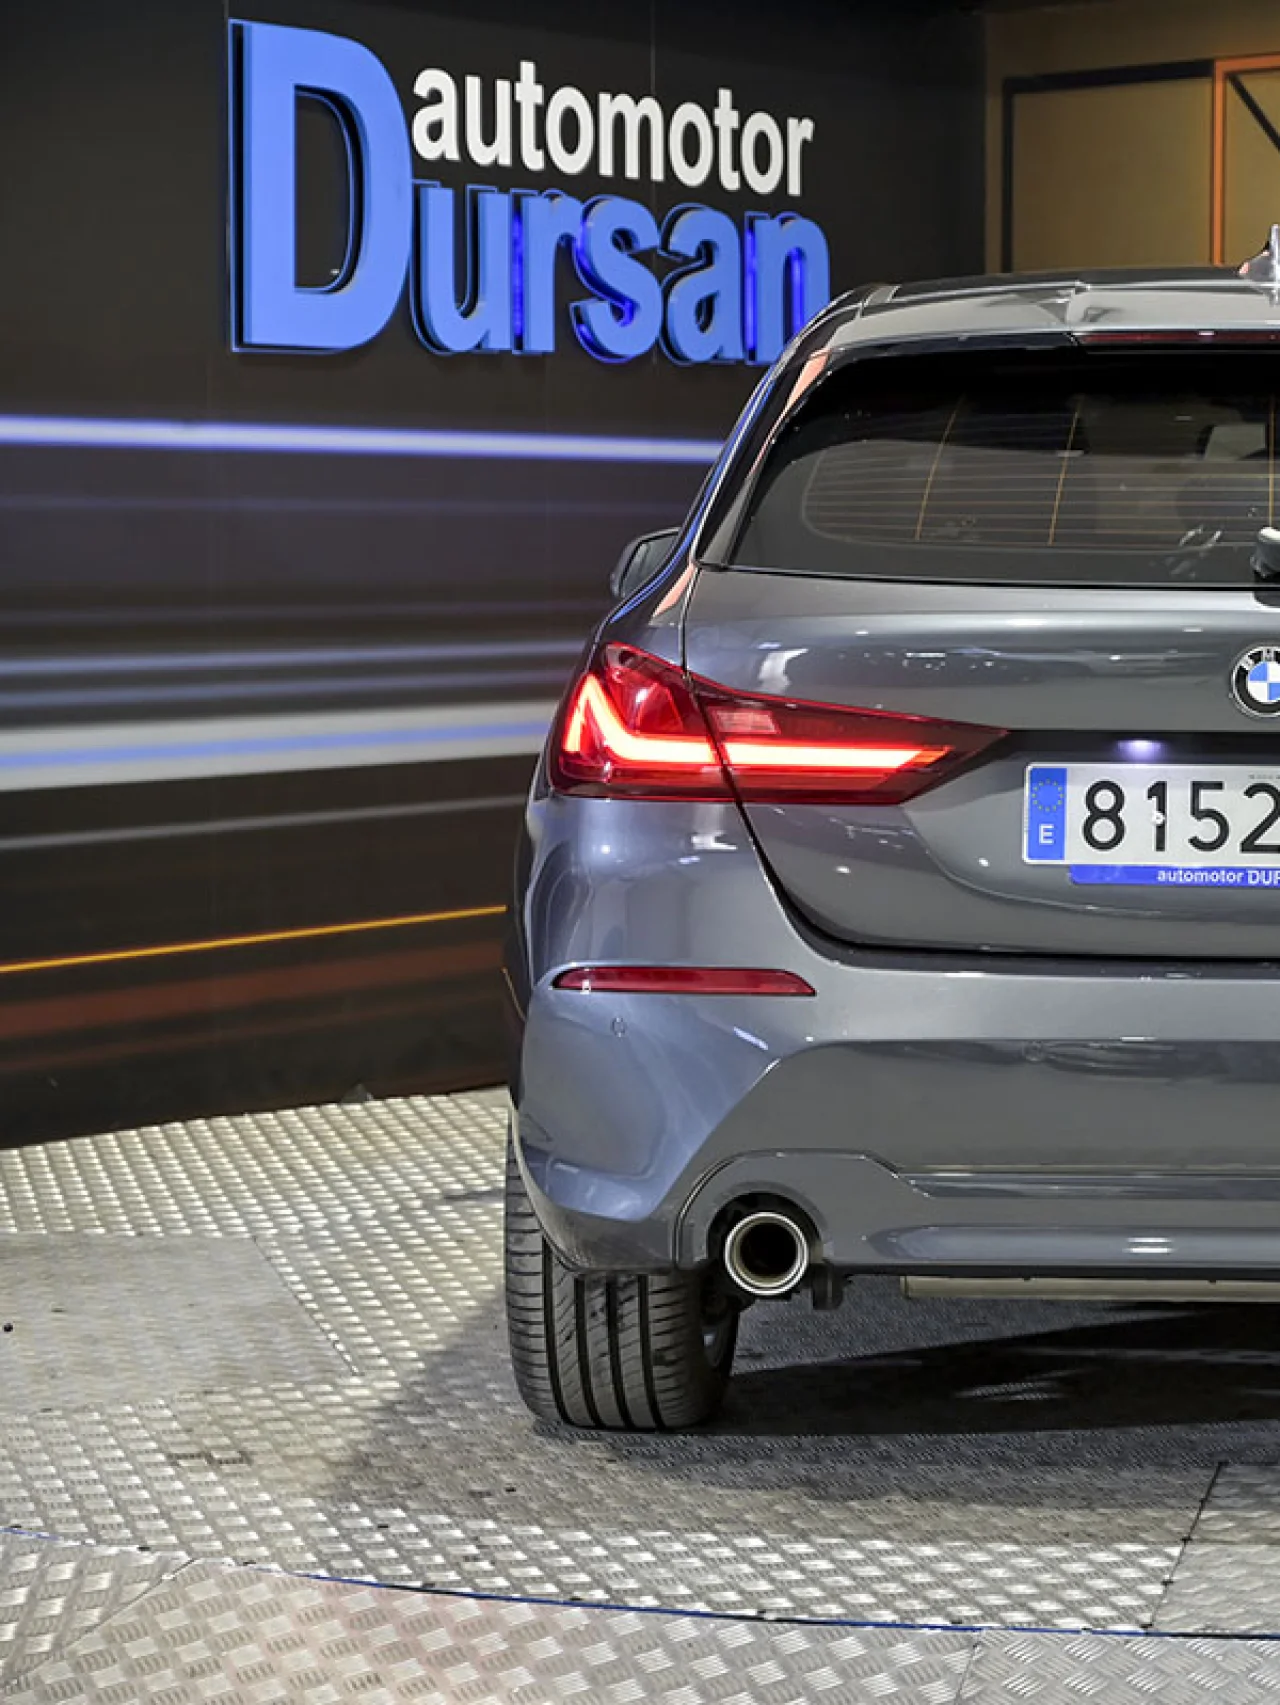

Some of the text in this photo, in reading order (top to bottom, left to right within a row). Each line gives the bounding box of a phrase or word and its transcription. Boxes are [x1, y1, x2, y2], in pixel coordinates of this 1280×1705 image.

[411, 61, 815, 196] automotor
[228, 18, 831, 365] Dursan
[1039, 823, 1055, 845] E
[1157, 869, 1244, 884] automotor
